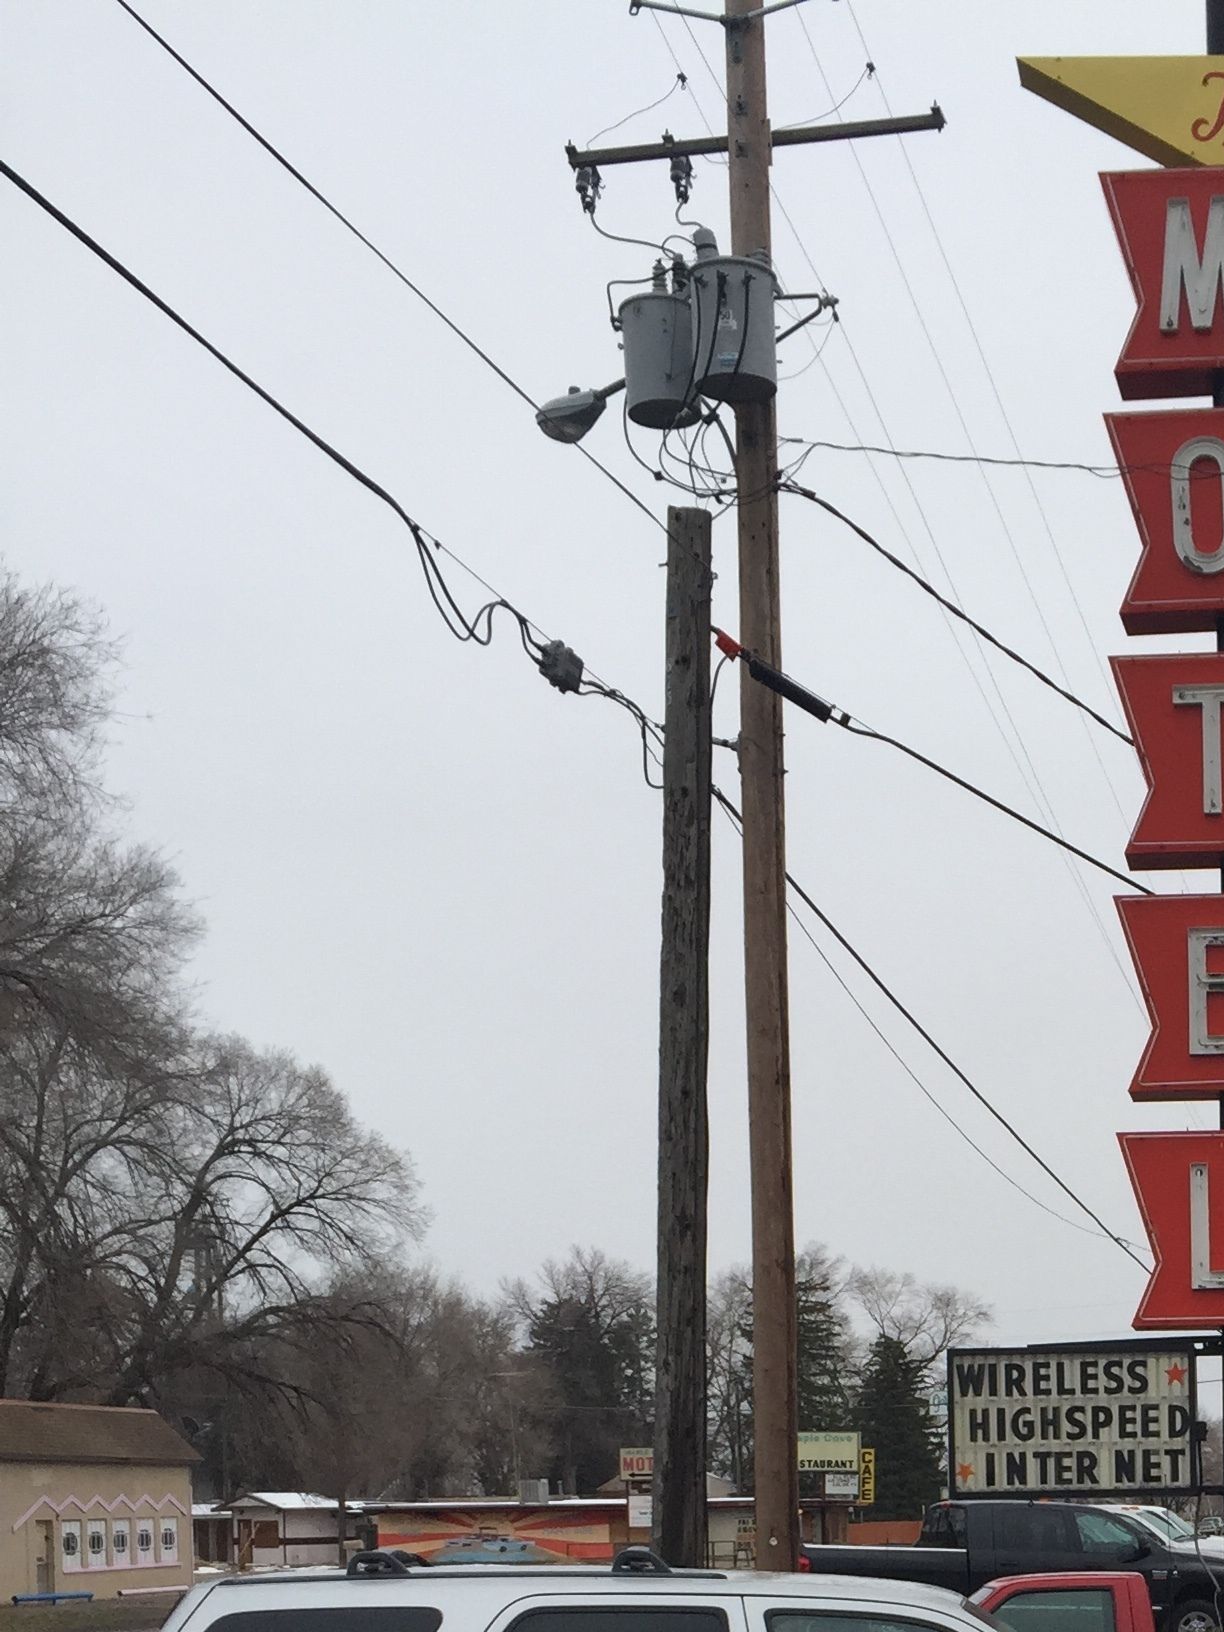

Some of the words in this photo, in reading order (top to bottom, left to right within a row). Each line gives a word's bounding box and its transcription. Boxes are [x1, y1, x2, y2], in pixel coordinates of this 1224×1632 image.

[956, 1360, 1150, 1398] WIRELESS
[969, 1403, 1191, 1443] HIGHSPEED
[861, 1451, 873, 1501] CAFE
